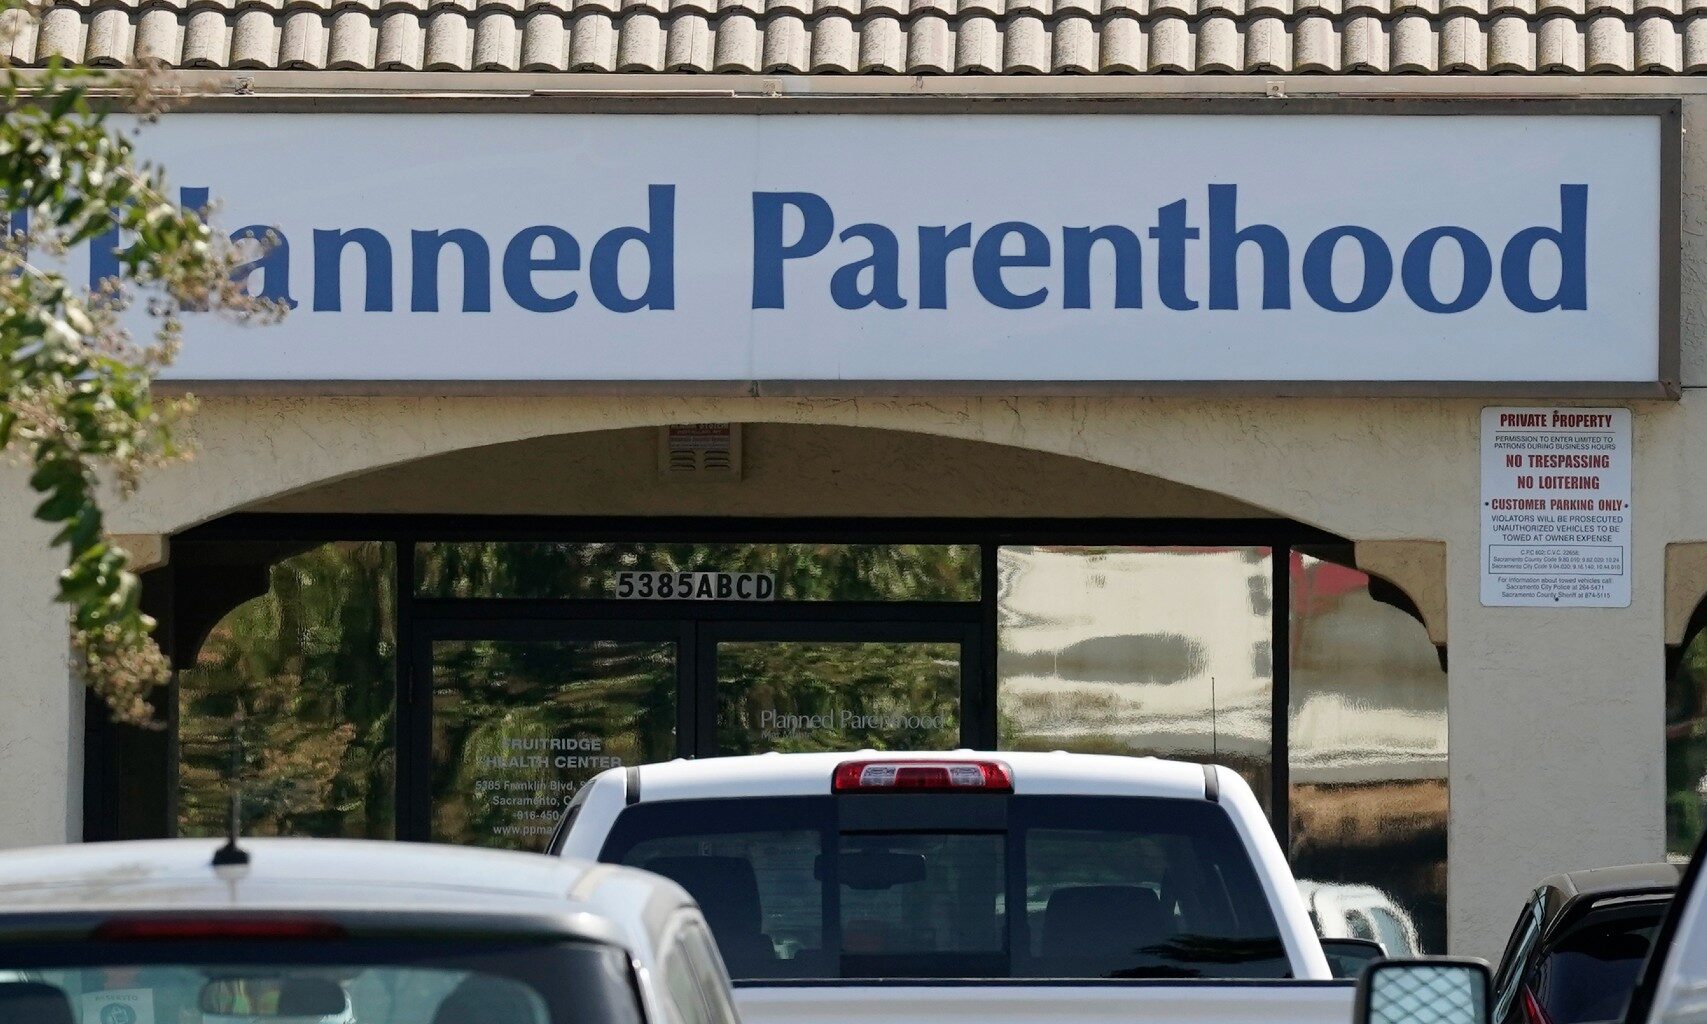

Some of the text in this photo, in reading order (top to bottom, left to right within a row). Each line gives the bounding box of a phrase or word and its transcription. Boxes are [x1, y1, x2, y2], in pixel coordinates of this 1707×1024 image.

[752, 184, 1589, 314] Parenthood
[1500, 413, 1612, 427] PRIVATE PROPERTY
[1506, 454, 1610, 468] NO TRESPASSING
[1517, 476, 1600, 490] NO LOITERING
[1491, 499, 1622, 511] CUSTOMER PARKING ONLY
[618, 572, 773, 599] 5385ABCD
[760, 709, 834, 729] Planned
[485, 756, 622, 768] HEALTH CENTER
[476, 781, 500, 790] 5385
[492, 795, 560, 807] Sacramento,
[517, 811, 563, 820] 916-450-
